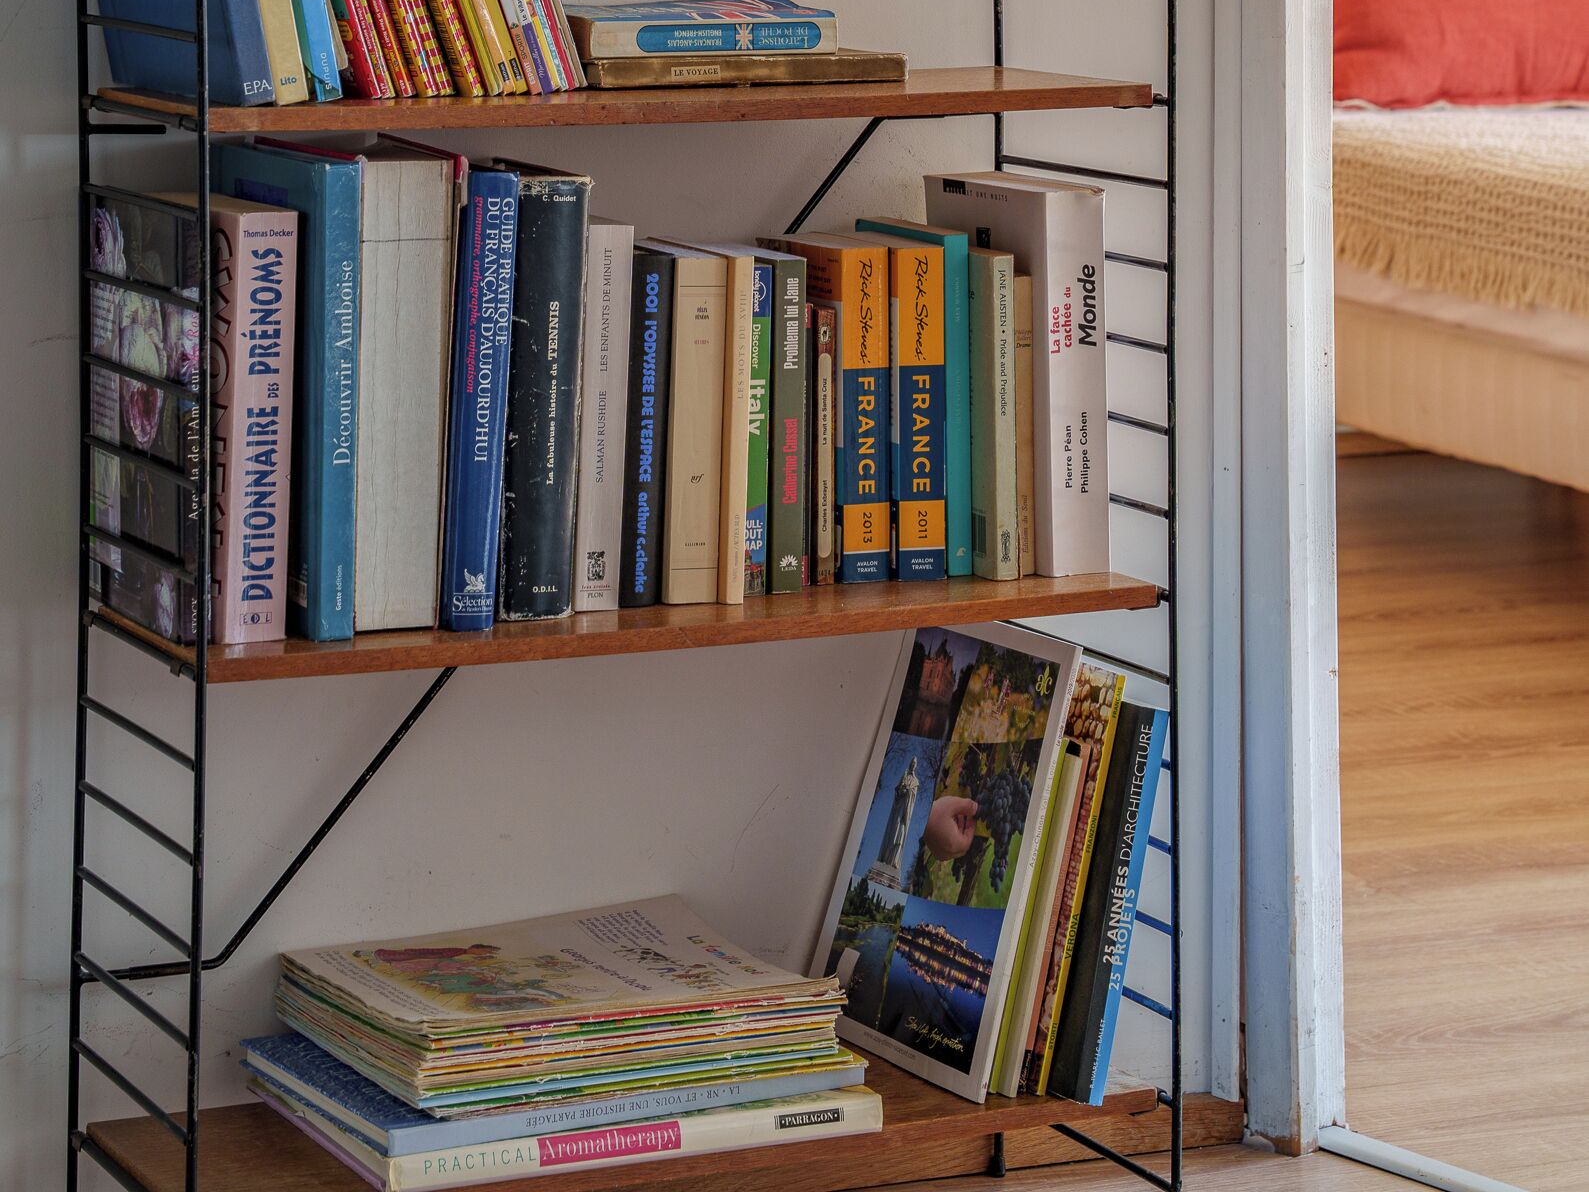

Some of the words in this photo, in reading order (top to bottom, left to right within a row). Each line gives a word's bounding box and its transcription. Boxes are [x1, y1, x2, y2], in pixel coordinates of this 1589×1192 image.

[520, 13, 528, 21] Le
[280, 75, 297, 87] Lito
[320, 53, 332, 90] DUPUIS
[523, 61, 536, 85] ESPRIT
[674, 69, 684, 77] LE
[686, 67, 719, 76] VOYAGE
[243, 80, 272, 96] EPA
[488, 198, 500, 224] DU
[553, 194, 576, 202] Quidet
[990, 193, 1008, 202] NUITS
[244, 229, 268, 238] Thomas
[270, 229, 294, 238] Decker
[472, 196, 483, 256] grammaire,
[500, 198, 514, 253] GUIDE
[481, 230, 499, 317] FRANÇAIS
[604, 248, 612, 286] MINUIT
[859, 258, 872, 304] Rick
[914, 256, 928, 304] Rick
[998, 270, 1006, 295] JANE
[338, 261, 354, 349] Amboise
[469, 260, 480, 327] orthographe,
[495, 258, 512, 346] PRATIQUE
[603, 289, 611, 302] DE
[646, 274, 660, 313] 2001
[784, 278, 799, 302] Jane
[1064, 286, 1070, 298] du
[1077, 264, 1097, 346] Monde
[241, 248, 284, 375] PRÉNOMS
[784, 306, 798, 319] lui
[1051, 306, 1060, 335] face
[1062, 302, 1072, 348] cachée
[548, 301, 560, 360] TENNIS
[602, 304, 610, 352] ENFANTS
[752, 324, 760, 368] Discover
[784, 320, 798, 370] Problema
[1051, 338, 1060, 354] La
[466, 330, 476, 393] conjugaison
[551, 363, 558, 376] du
[600, 353, 608, 372] LES
[268, 382, 279, 398] DES
[474, 322, 494, 462] D'AUJOURD'HUI
[549, 380, 558, 418] histoire
[642, 396, 654, 415] DE
[333, 360, 353, 466] Découvrir
[598, 390, 607, 437] RUSHDIE
[749, 379, 766, 436] Italy
[823, 414, 828, 422] de
[822, 438, 828, 446] La
[858, 377, 876, 494] FRANCE
[912, 375, 930, 493] FRANCE
[596, 440, 606, 483] SALMAN
[1080, 449, 1088, 494] Philippe
[547, 476, 554, 485] La
[242, 406, 279, 601] DICTIONNAIRE
[638, 492, 648, 535] arthur
[863, 512, 872, 544] 2013
[918, 510, 928, 539] 2011
[452, 596, 493, 612] Sélection
[1120, 724, 1153, 861] D'ARCHITECTURE
[1065, 913, 1080, 959] VERONA
[1086, 814, 1097, 854] FRANZONI
[1106, 866, 1130, 942] ANNÉES
[1113, 888, 1136, 966] PROJETS
[1102, 945, 1115, 964] 25
[1109, 972, 1121, 990] 25
[1096, 1018, 1106, 1043] BALLET
[632, 1099, 650, 1110] UNE
[686, 1091, 698, 1101] ET
[706, 1089, 720, 1098] NR
[728, 1086, 740, 1096] LA
[526, 1109, 578, 1128] PARTAGÉE
[580, 1101, 630, 1118] HISTOIRE
[783, 1111, 834, 1128] PARRAGON
[424, 1146, 536, 1175] PRACTICAL
[542, 1126, 680, 1162] Aromatherapy
